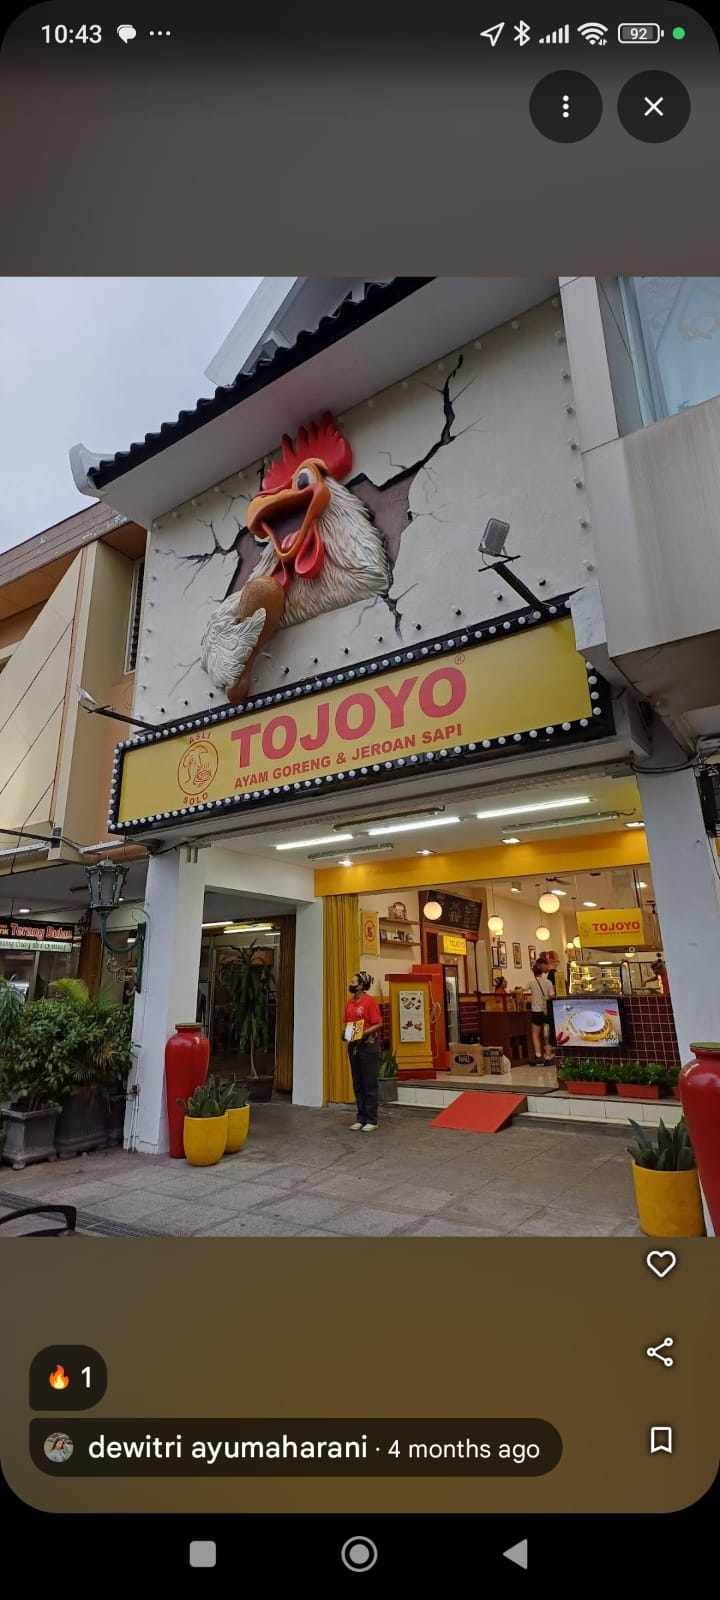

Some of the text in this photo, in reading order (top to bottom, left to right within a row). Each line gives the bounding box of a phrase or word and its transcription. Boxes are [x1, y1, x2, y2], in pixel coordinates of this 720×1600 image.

[231, 667, 467, 769] TOJOYO
[189, 731, 211, 745] ASLI
[234, 723, 462, 790] AYAM GORENG & JEROAN SAPI
[184, 792, 208, 805] SOLO
[592, 921, 640, 931] TOJOYO
